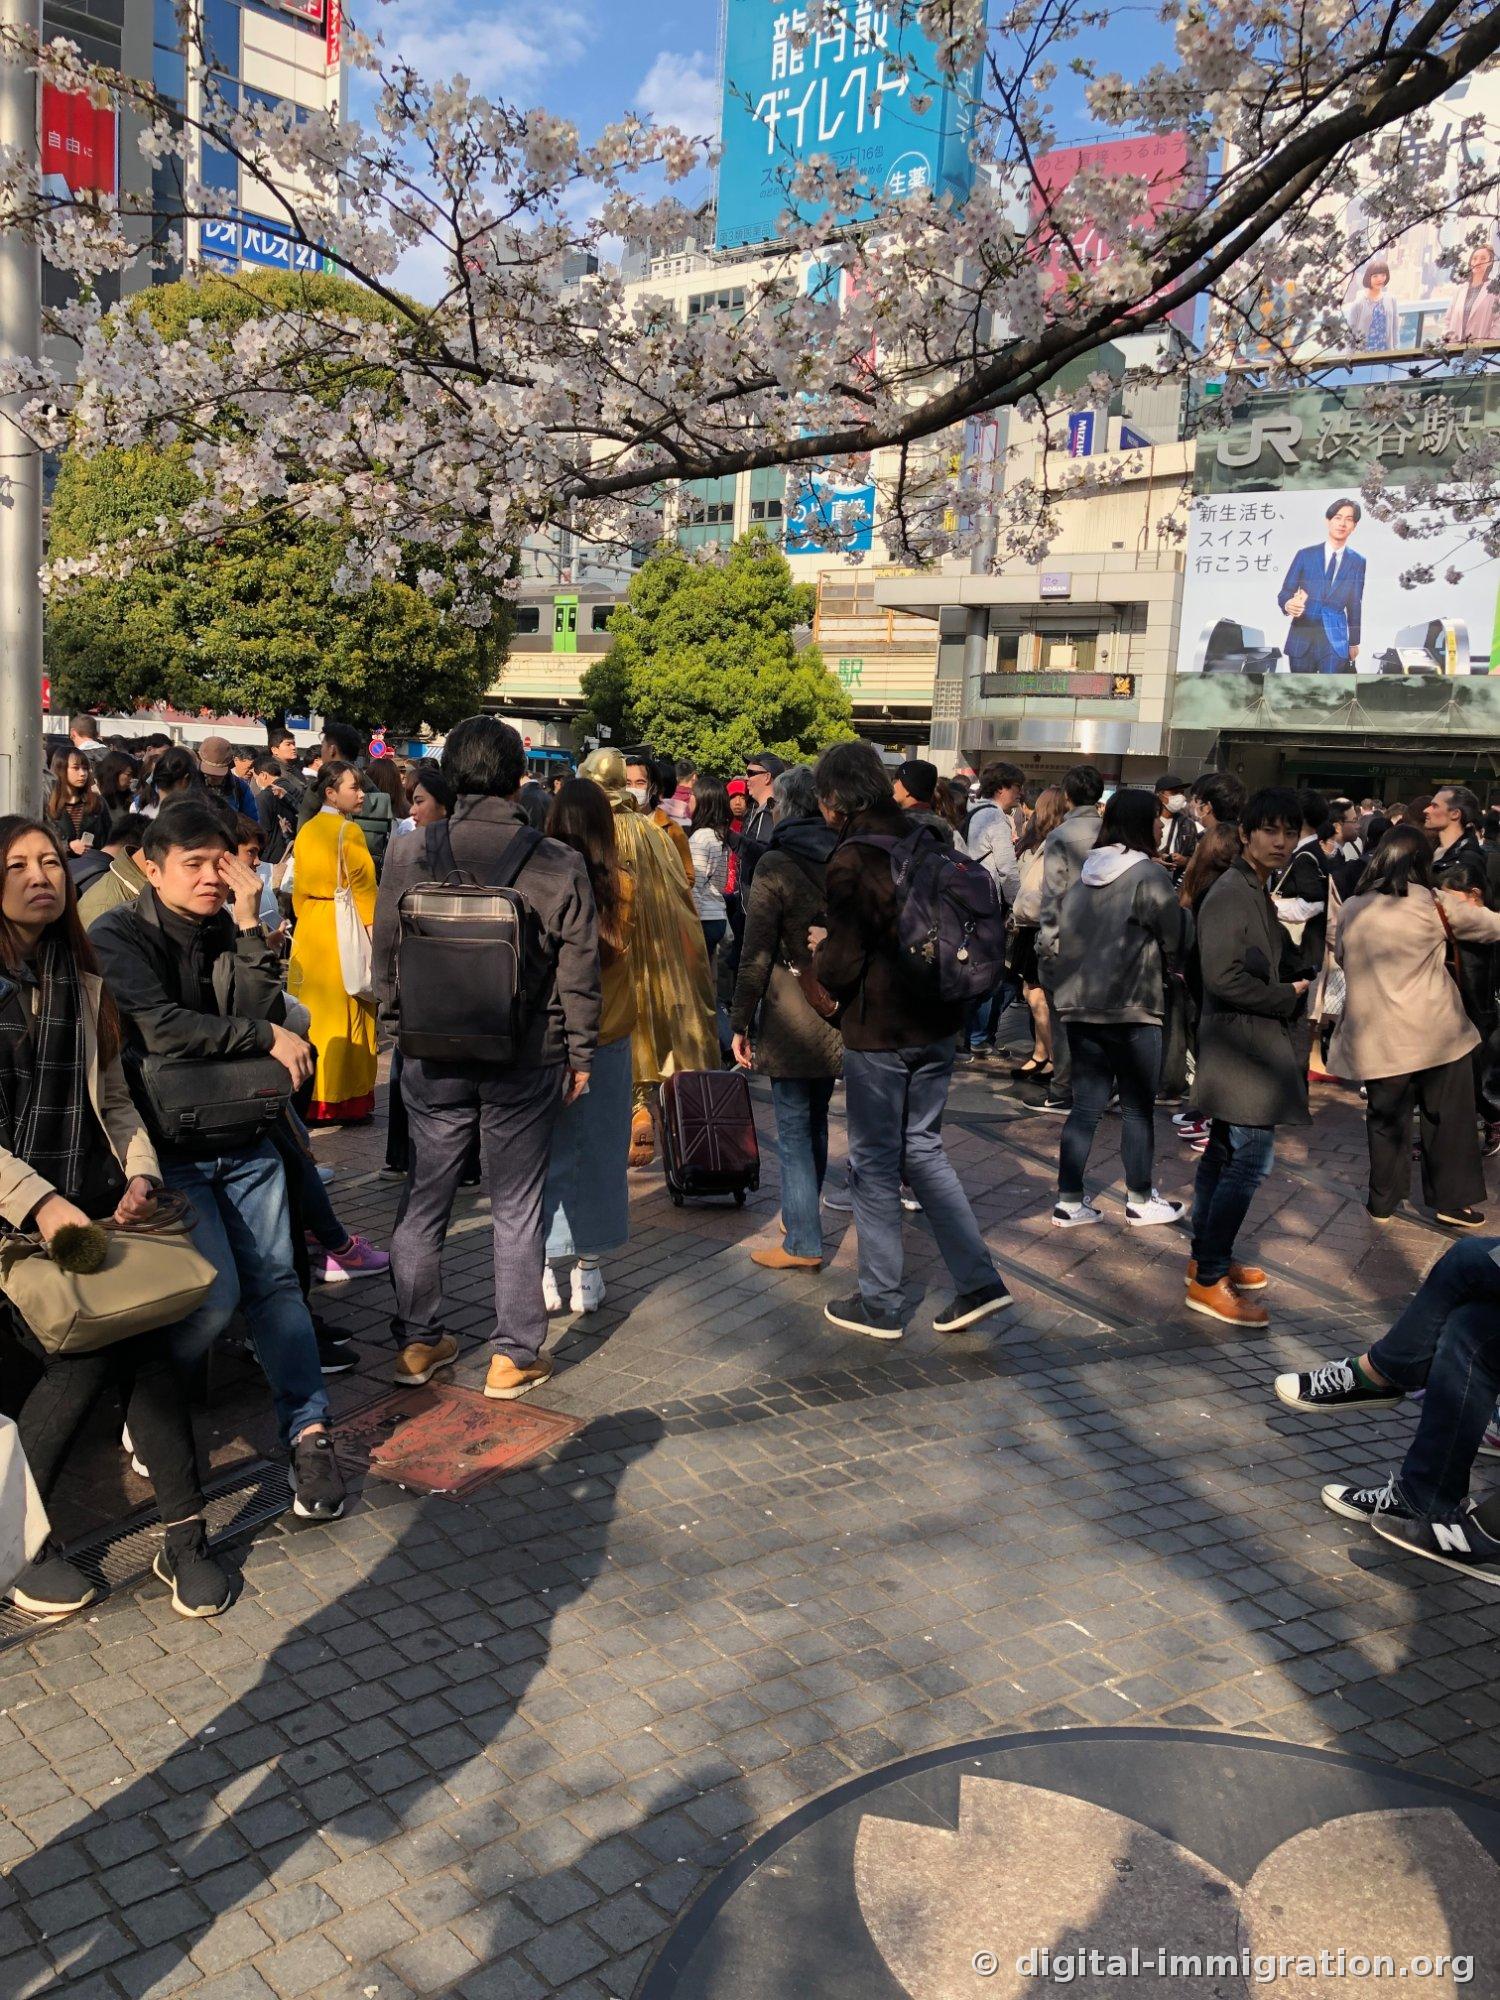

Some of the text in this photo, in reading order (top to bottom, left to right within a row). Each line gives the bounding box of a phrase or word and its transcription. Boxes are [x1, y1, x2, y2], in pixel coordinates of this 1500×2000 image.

[752, 61, 909, 154] ダイレクト
[889, 166, 927, 195] 生薬
[1217, 404, 1472, 468] JR 渋谷駅
[1198, 502, 1286, 523] 新生活も、
[1198, 528, 1273, 548] スイスイ
[1195, 554, 1280, 574] 行こうぜ。
[1431, 1523, 1471, 1552] N
